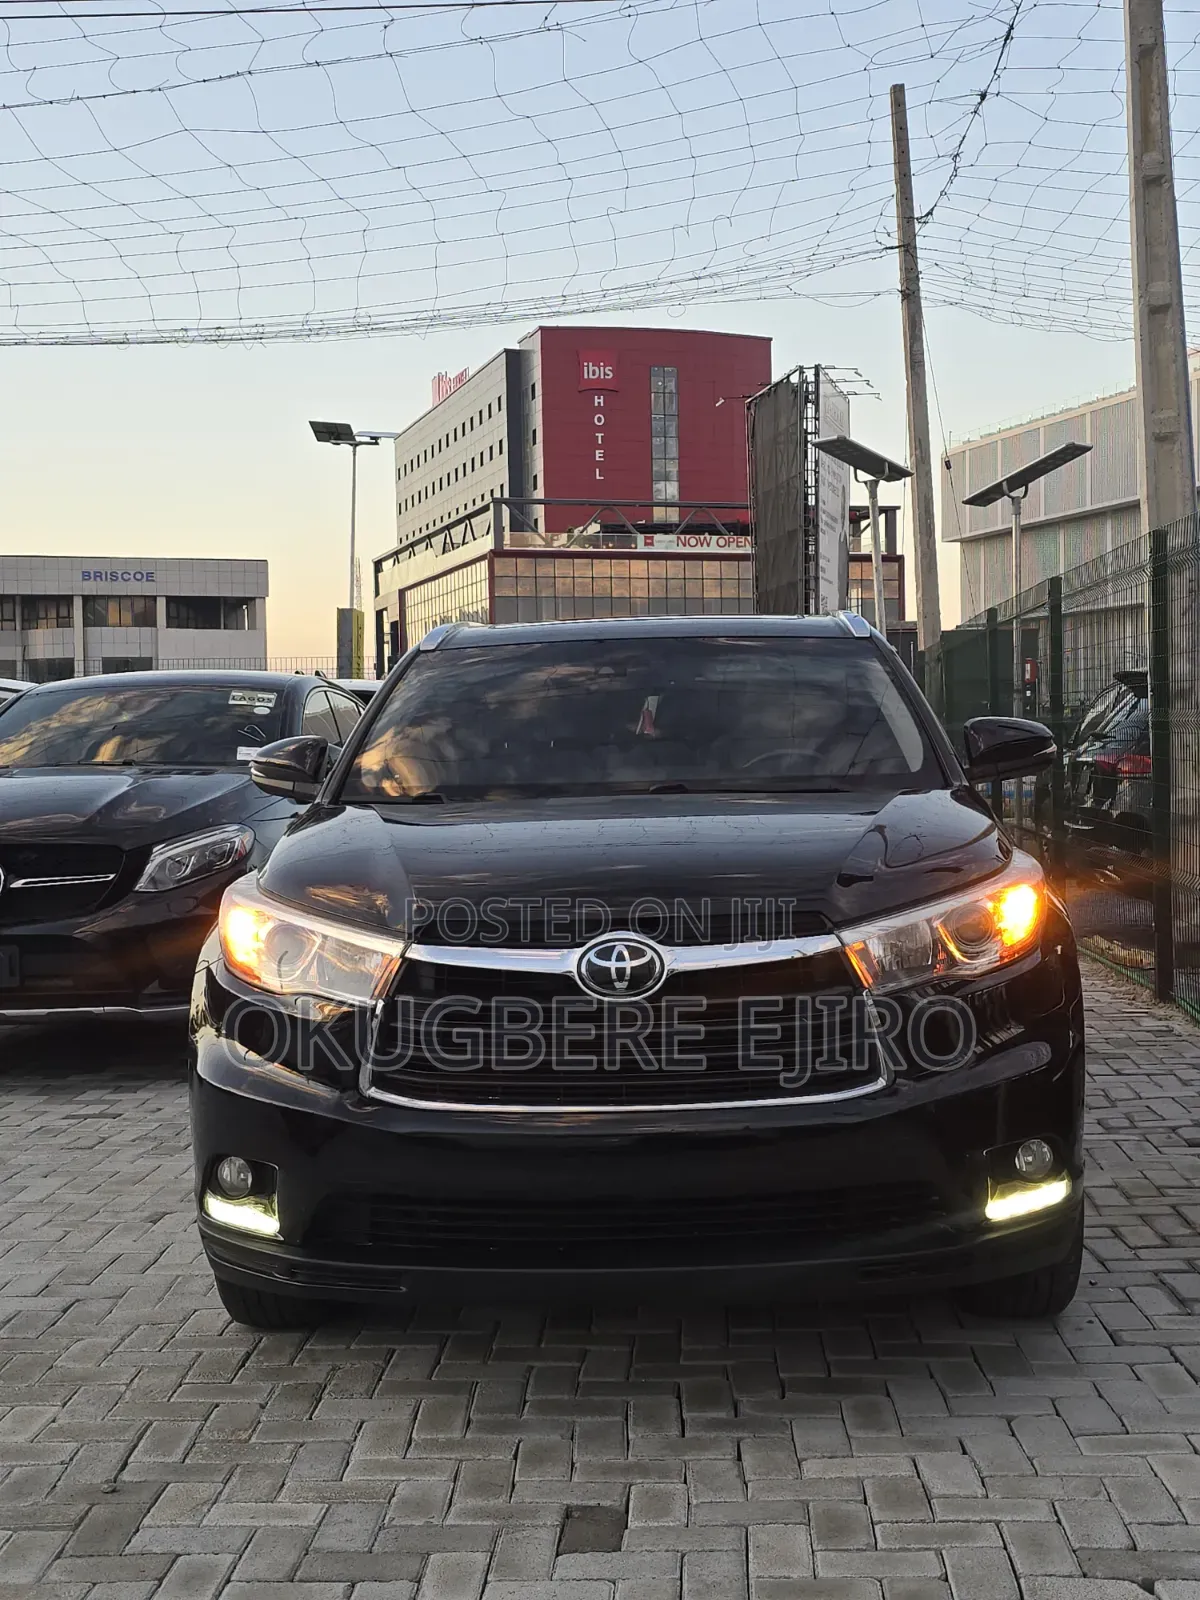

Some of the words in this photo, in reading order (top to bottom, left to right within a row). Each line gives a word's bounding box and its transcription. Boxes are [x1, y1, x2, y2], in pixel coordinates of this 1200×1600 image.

[583, 362, 613, 379] ibis
[594, 395, 605, 480] HOTEL
[676, 535, 712, 548] NOW
[716, 536, 752, 548] OPEN
[81, 570, 155, 582] BRISCOE
